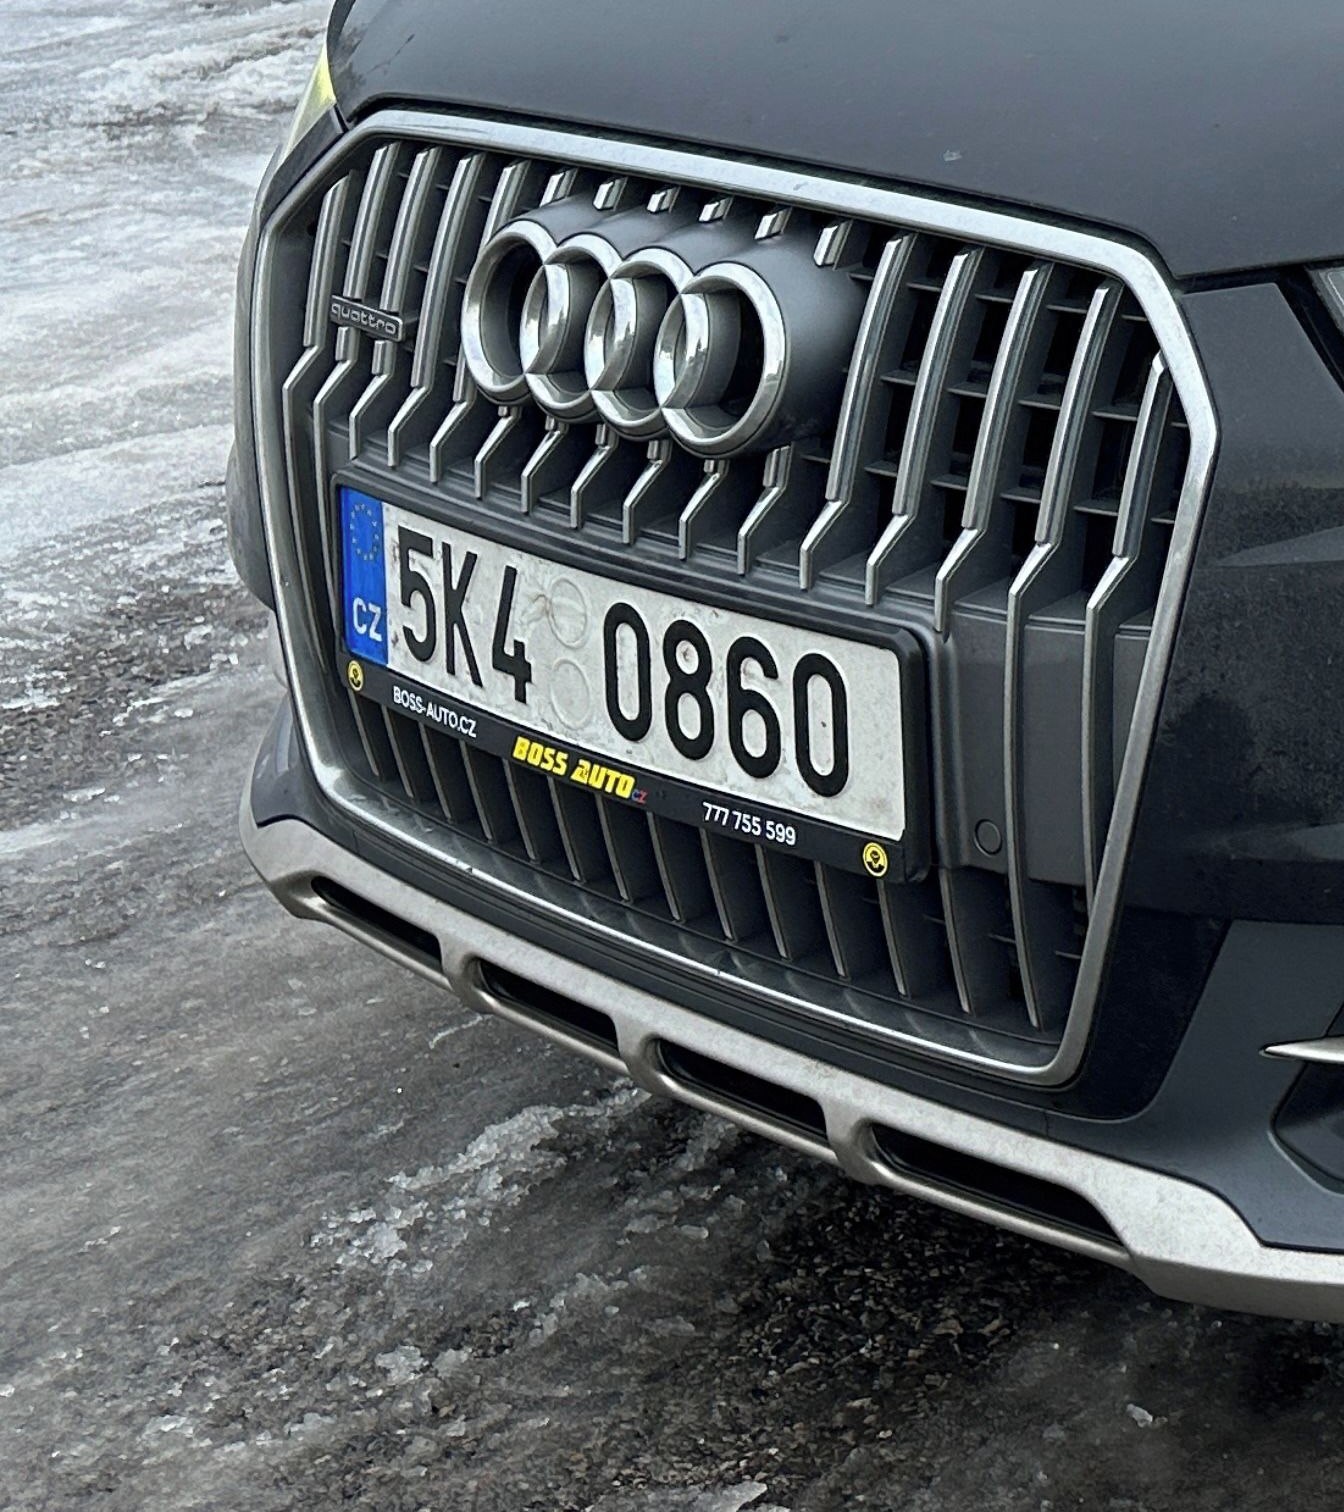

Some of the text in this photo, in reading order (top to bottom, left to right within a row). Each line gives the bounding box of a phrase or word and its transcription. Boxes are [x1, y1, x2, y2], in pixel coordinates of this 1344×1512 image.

[331, 302, 397, 335] quattro
[353, 597, 383, 642] CZ
[398, 524, 850, 798] 5K4 0860
[393, 686, 477, 738] BOSS-AUTO.CZ
[512, 736, 568, 776] BOSS
[571, 758, 635, 799] AUTO
[702, 801, 797, 847] 777 755 599
